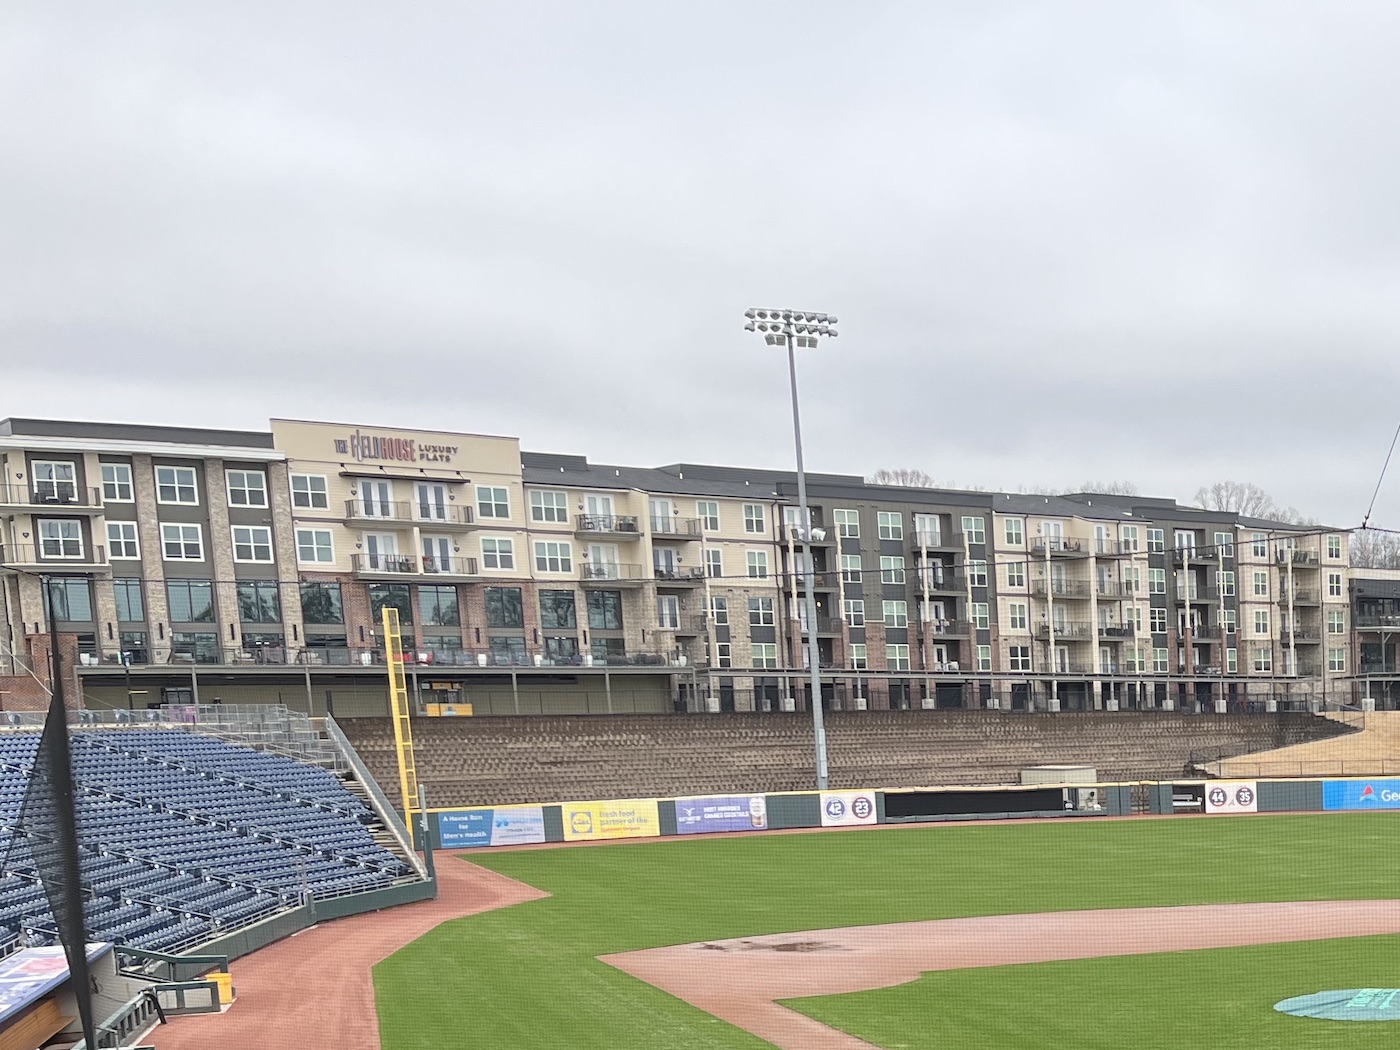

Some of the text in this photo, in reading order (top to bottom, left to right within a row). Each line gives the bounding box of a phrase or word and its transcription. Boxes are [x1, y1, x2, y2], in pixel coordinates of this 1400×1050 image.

[333, 429, 417, 462] THE FIELDHOUSE
[418, 444, 459, 454] LUXURY
[419, 453, 451, 462] FLATS
[1212, 792, 1224, 802] 44
[1239, 791, 1251, 802] 35
[828, 802, 842, 814] 42
[855, 802, 869, 813] 23
[619, 809, 635, 817] food
[600, 818, 626, 826] partner
